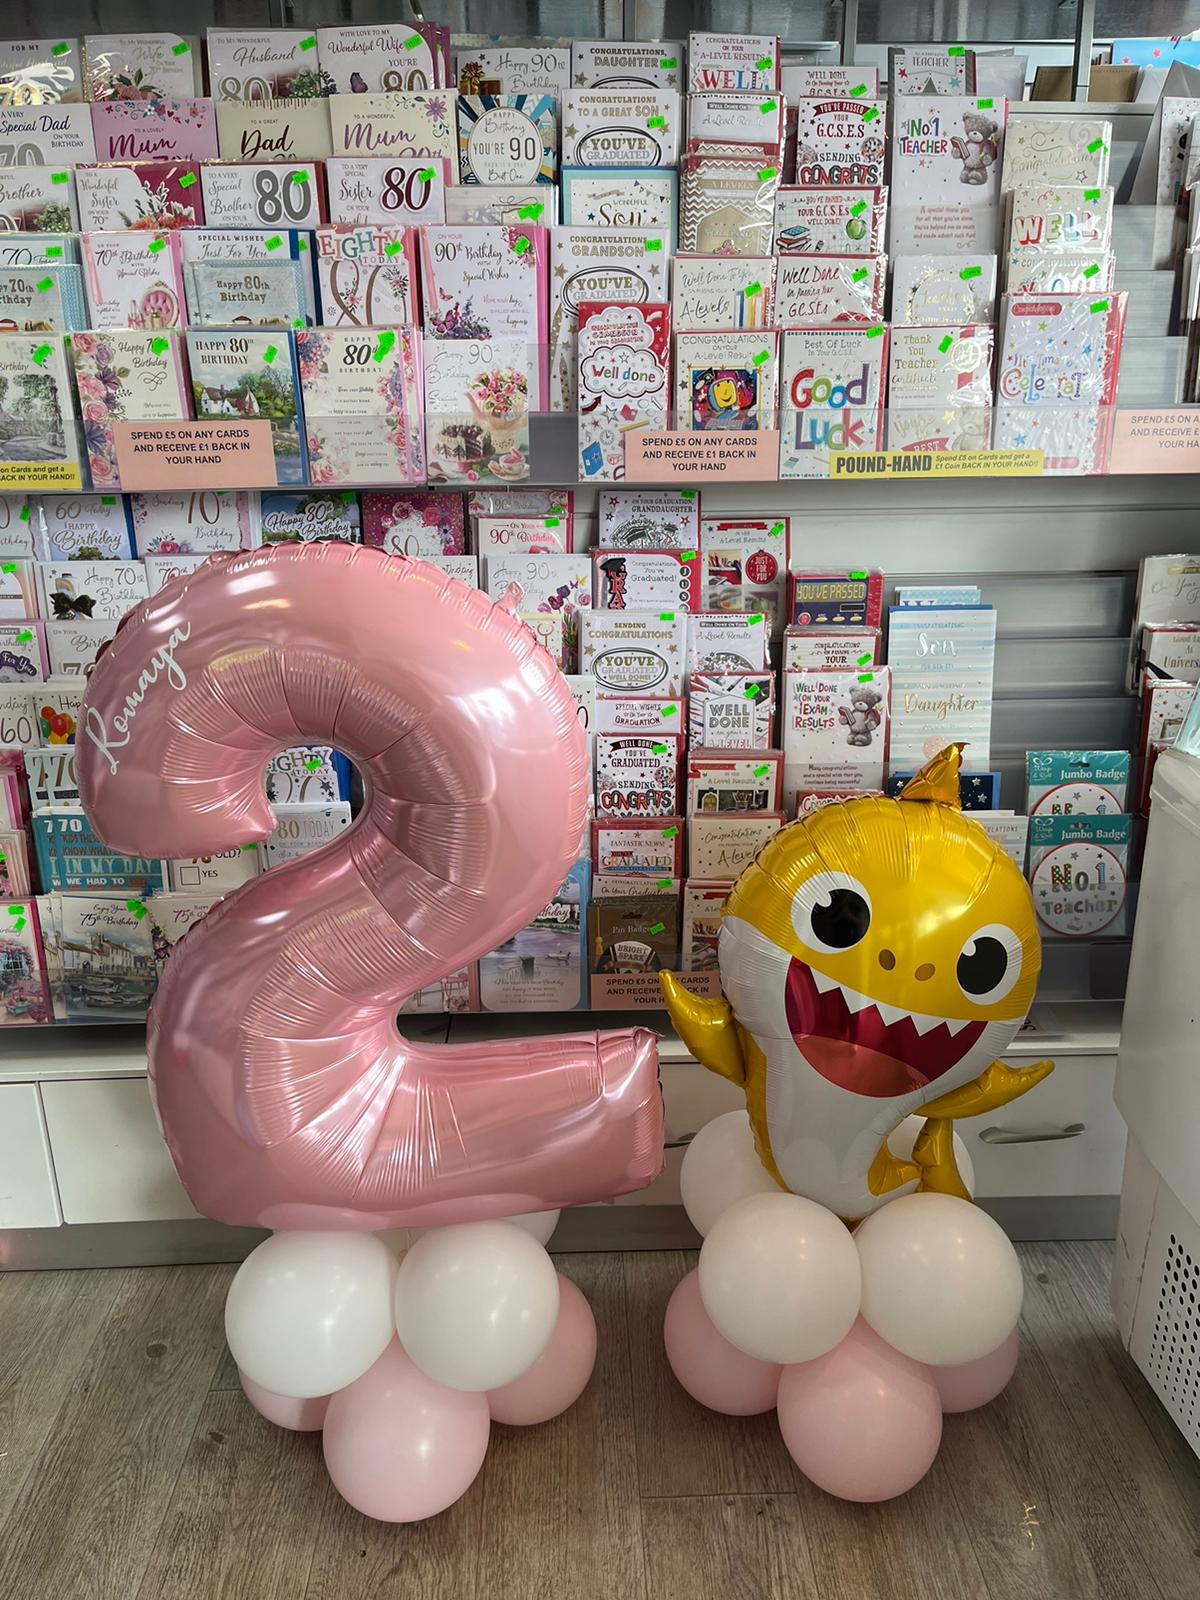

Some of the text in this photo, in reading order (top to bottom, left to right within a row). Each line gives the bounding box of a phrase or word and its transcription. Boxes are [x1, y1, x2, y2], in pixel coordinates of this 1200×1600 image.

[328, 37, 405, 54] Wonderful Wife
[233, 47, 296, 66] Husband
[594, 57, 658, 67] DAUGHTER
[510, 74, 560, 94] Birthday
[703, 70, 763, 89] WELL
[578, 106, 659, 116] TO A GREAT SON
[240, 125, 294, 153] Dad
[344, 123, 416, 151] Mum
[109, 135, 176, 158] Mum
[473, 137, 535, 160] YOU'RE 90
[591, 138, 646, 151] YOU'VE
[587, 151, 650, 160] GRADUATED
[820, 153, 861, 162] SENDING
[339, 180, 375, 200] Sister
[381, 167, 431, 211] 80
[256, 170, 311, 221] 80
[211, 200, 252, 214] Brother
[599, 203, 643, 225] Son
[572, 246, 644, 257] GRANDSON
[783, 267, 839, 284] Well Done
[577, 277, 632, 290] YOU'VE
[220, 292, 266, 303] Birthday
[682, 335, 768, 345] CONGRATULATIONS
[201, 355, 248, 364] BIRTHDAY
[895, 359, 937, 370] Teacher
[592, 364, 655, 382] Well done
[791, 364, 870, 409] Good
[131, 430, 249, 440] SPEND £5 ON ANY CARDS
[1152, 428, 1192, 436] RECEIVE
[134, 444, 151, 452] AND
[153, 443, 196, 452] RECEIVE
[199, 443, 209, 451] £1
[212, 443, 236, 451] BACK
[642, 438, 672, 446] SPEND
[166, 455, 222, 464] YOUR HAND
[720, 450, 744, 458] BACK
[836, 456, 932, 473] POUND-HAND
[55, 503, 81, 519] 60
[301, 522, 349, 540] Birthday
[53, 530, 121, 550] Birthday
[756, 565, 766, 573] FOR
[756, 573, 767, 581] YOU
[797, 584, 864, 600] YOU'VE PASSED
[589, 631, 672, 639] CONGRATULATIONS
[916, 633, 957, 656] Son
[4, 654, 35, 674] For You
[605, 657, 654, 666] YOU'VE
[826, 656, 847, 664] YOUR
[709, 705, 750, 715] WELL
[803, 704, 828, 715] EXAM
[904, 694, 978, 720] Daughter
[615, 716, 660, 725] GRADUATION
[710, 717, 749, 728] DONE
[795, 718, 834, 728] RESULTS
[1, 717, 31, 743] 60
[612, 759, 660, 768] GRADUATED
[1061, 770, 1092, 779] Jumbo
[1096, 769, 1126, 780] Badge
[617, 781, 655, 789] SENDING
[601, 790, 672, 810] CONGRATS
[705, 828, 762, 842] Congratulations
[1062, 830, 1126, 840] Jumbo Badge
[66, 859, 153, 873] IN MY DAY
[602, 856, 672, 866] GRADUATED
[94, 904, 109, 912] Enjoy
[1042, 900, 1117, 914] Teacher
[80, 913, 139, 929] 75th Birthday
[618, 945, 646, 954] BRIGHT
[618, 952, 644, 961] SPARK
